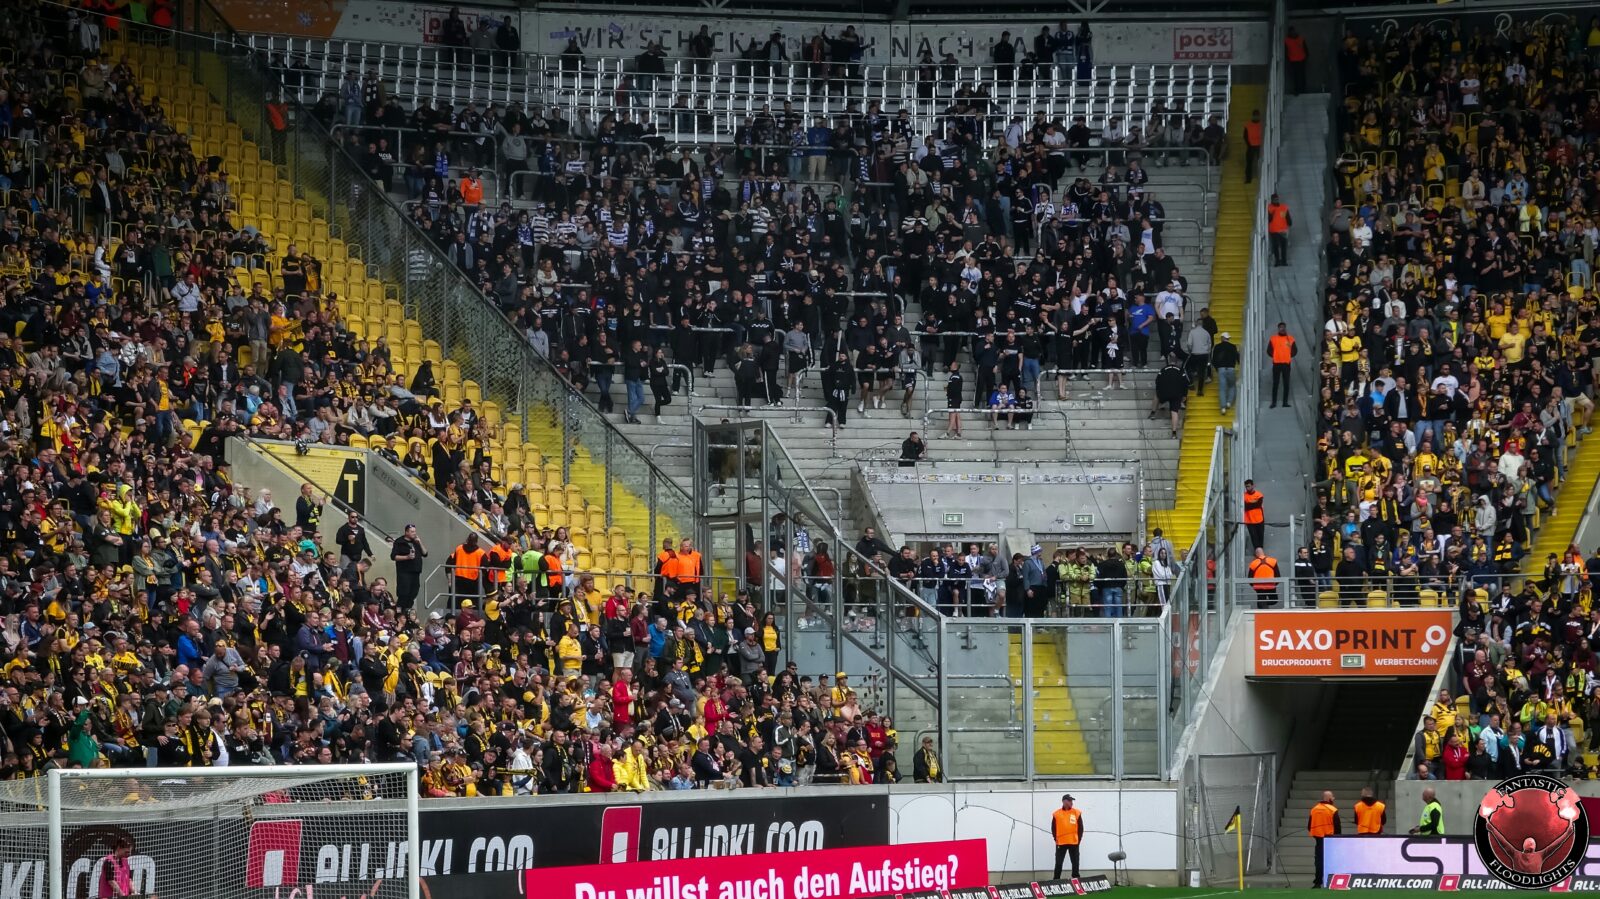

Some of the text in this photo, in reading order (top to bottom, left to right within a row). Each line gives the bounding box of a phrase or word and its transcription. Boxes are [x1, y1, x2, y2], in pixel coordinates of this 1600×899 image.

[429, 16, 473, 33] pt
[892, 36, 973, 58] NACH
[343, 473, 359, 504] T
[1259, 629, 1417, 651] SAXOPRINT
[1261, 657, 1439, 667] DRUCKPRODUKTE WERBETECHNIK
[719, 869, 784, 899] auch
[794, 866, 840, 899] den
[849, 854, 959, 895] Aufstieg?
[1352, 878, 1433, 889] ALL-INKL.COM
